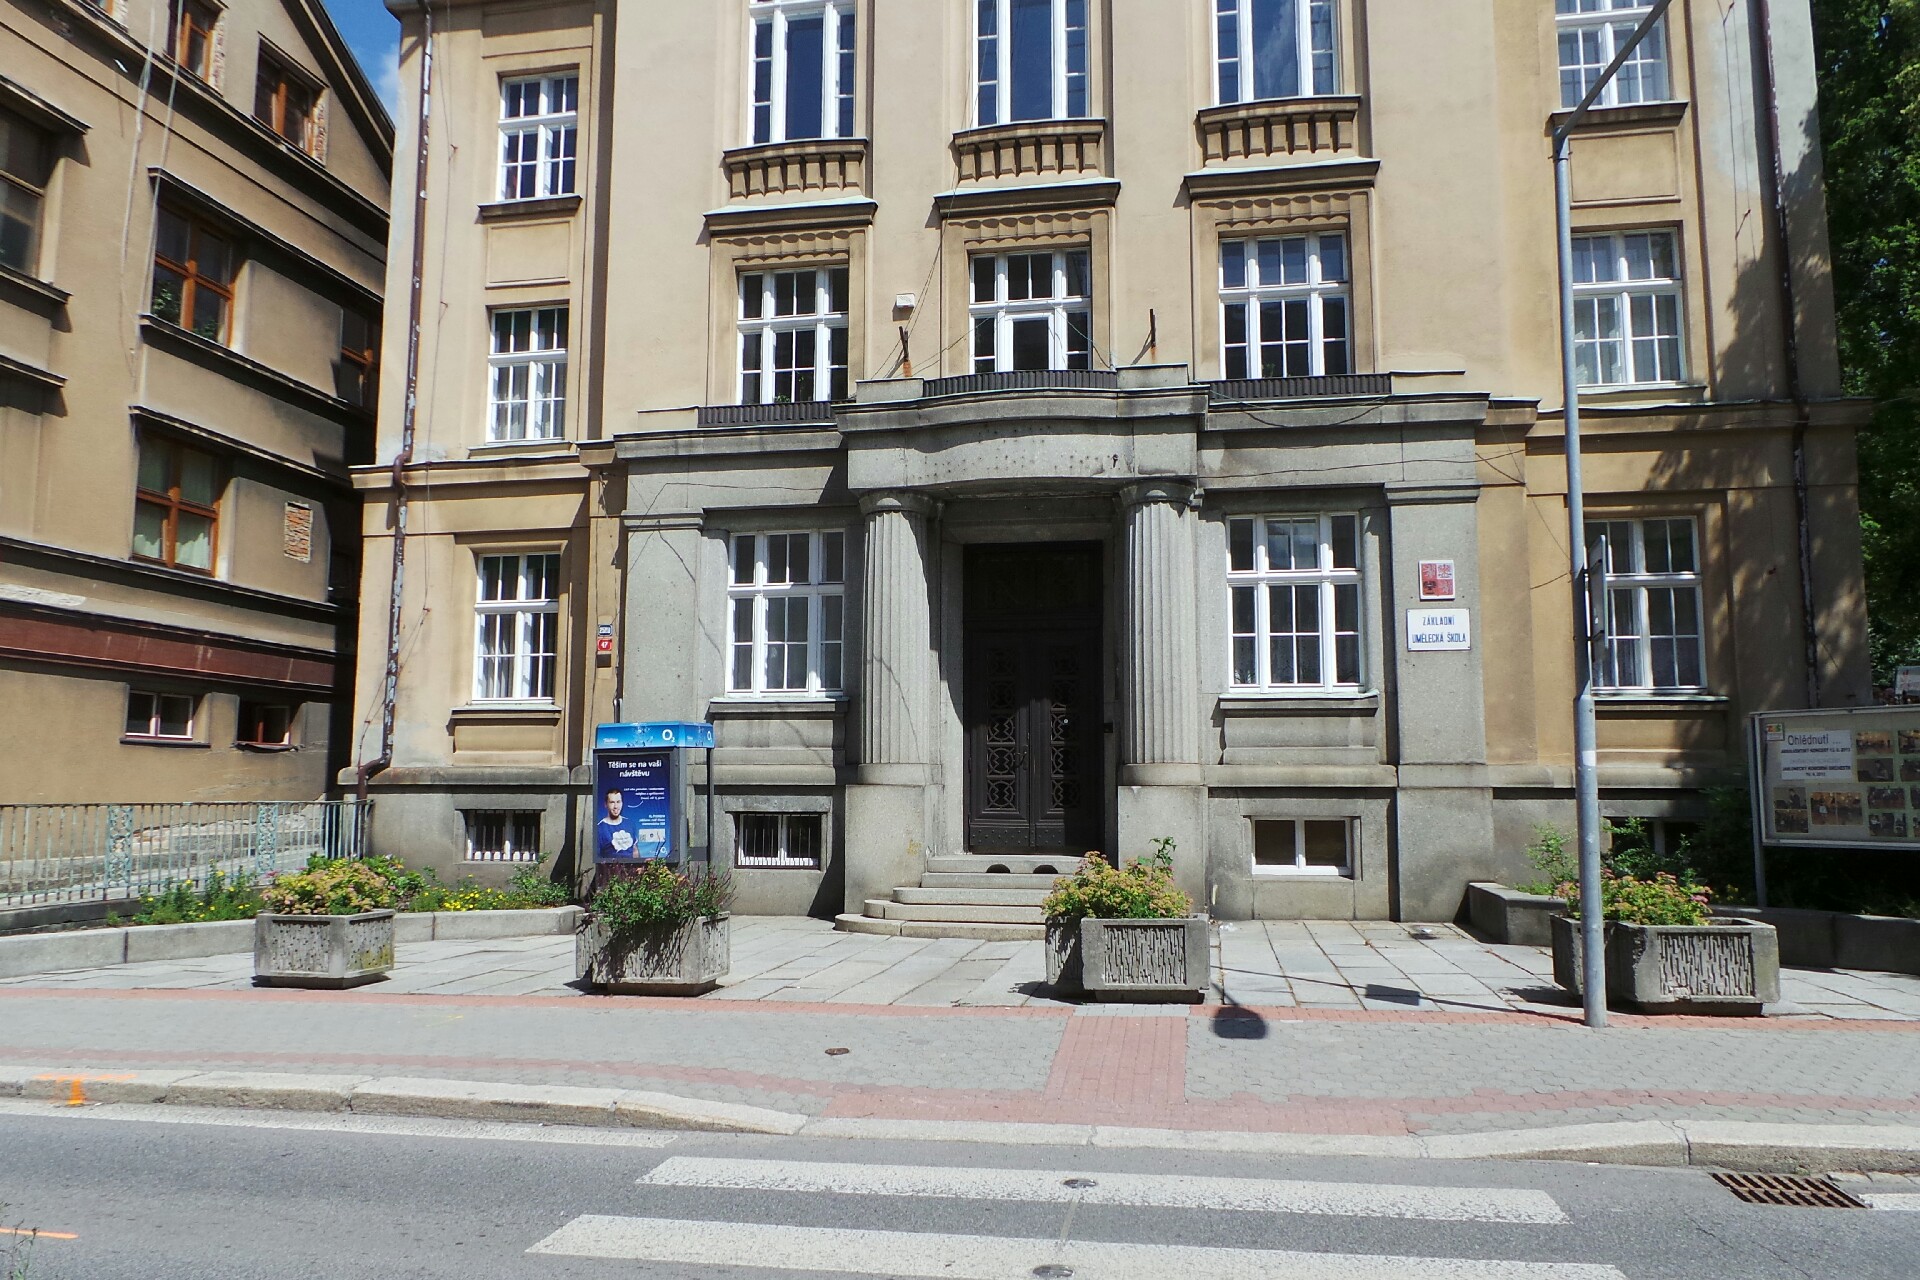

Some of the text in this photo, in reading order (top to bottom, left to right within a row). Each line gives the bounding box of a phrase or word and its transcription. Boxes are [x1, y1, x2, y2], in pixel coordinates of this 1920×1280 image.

[1422, 614, 1455, 625] ZÁKLADNÍ
[1412, 632, 1466, 643] UMĚLECKÁ ŠKOLA
[608, 760, 627, 769] Těším
[648, 760, 662, 768] vaši
[620, 770, 650, 778] návštěvu
